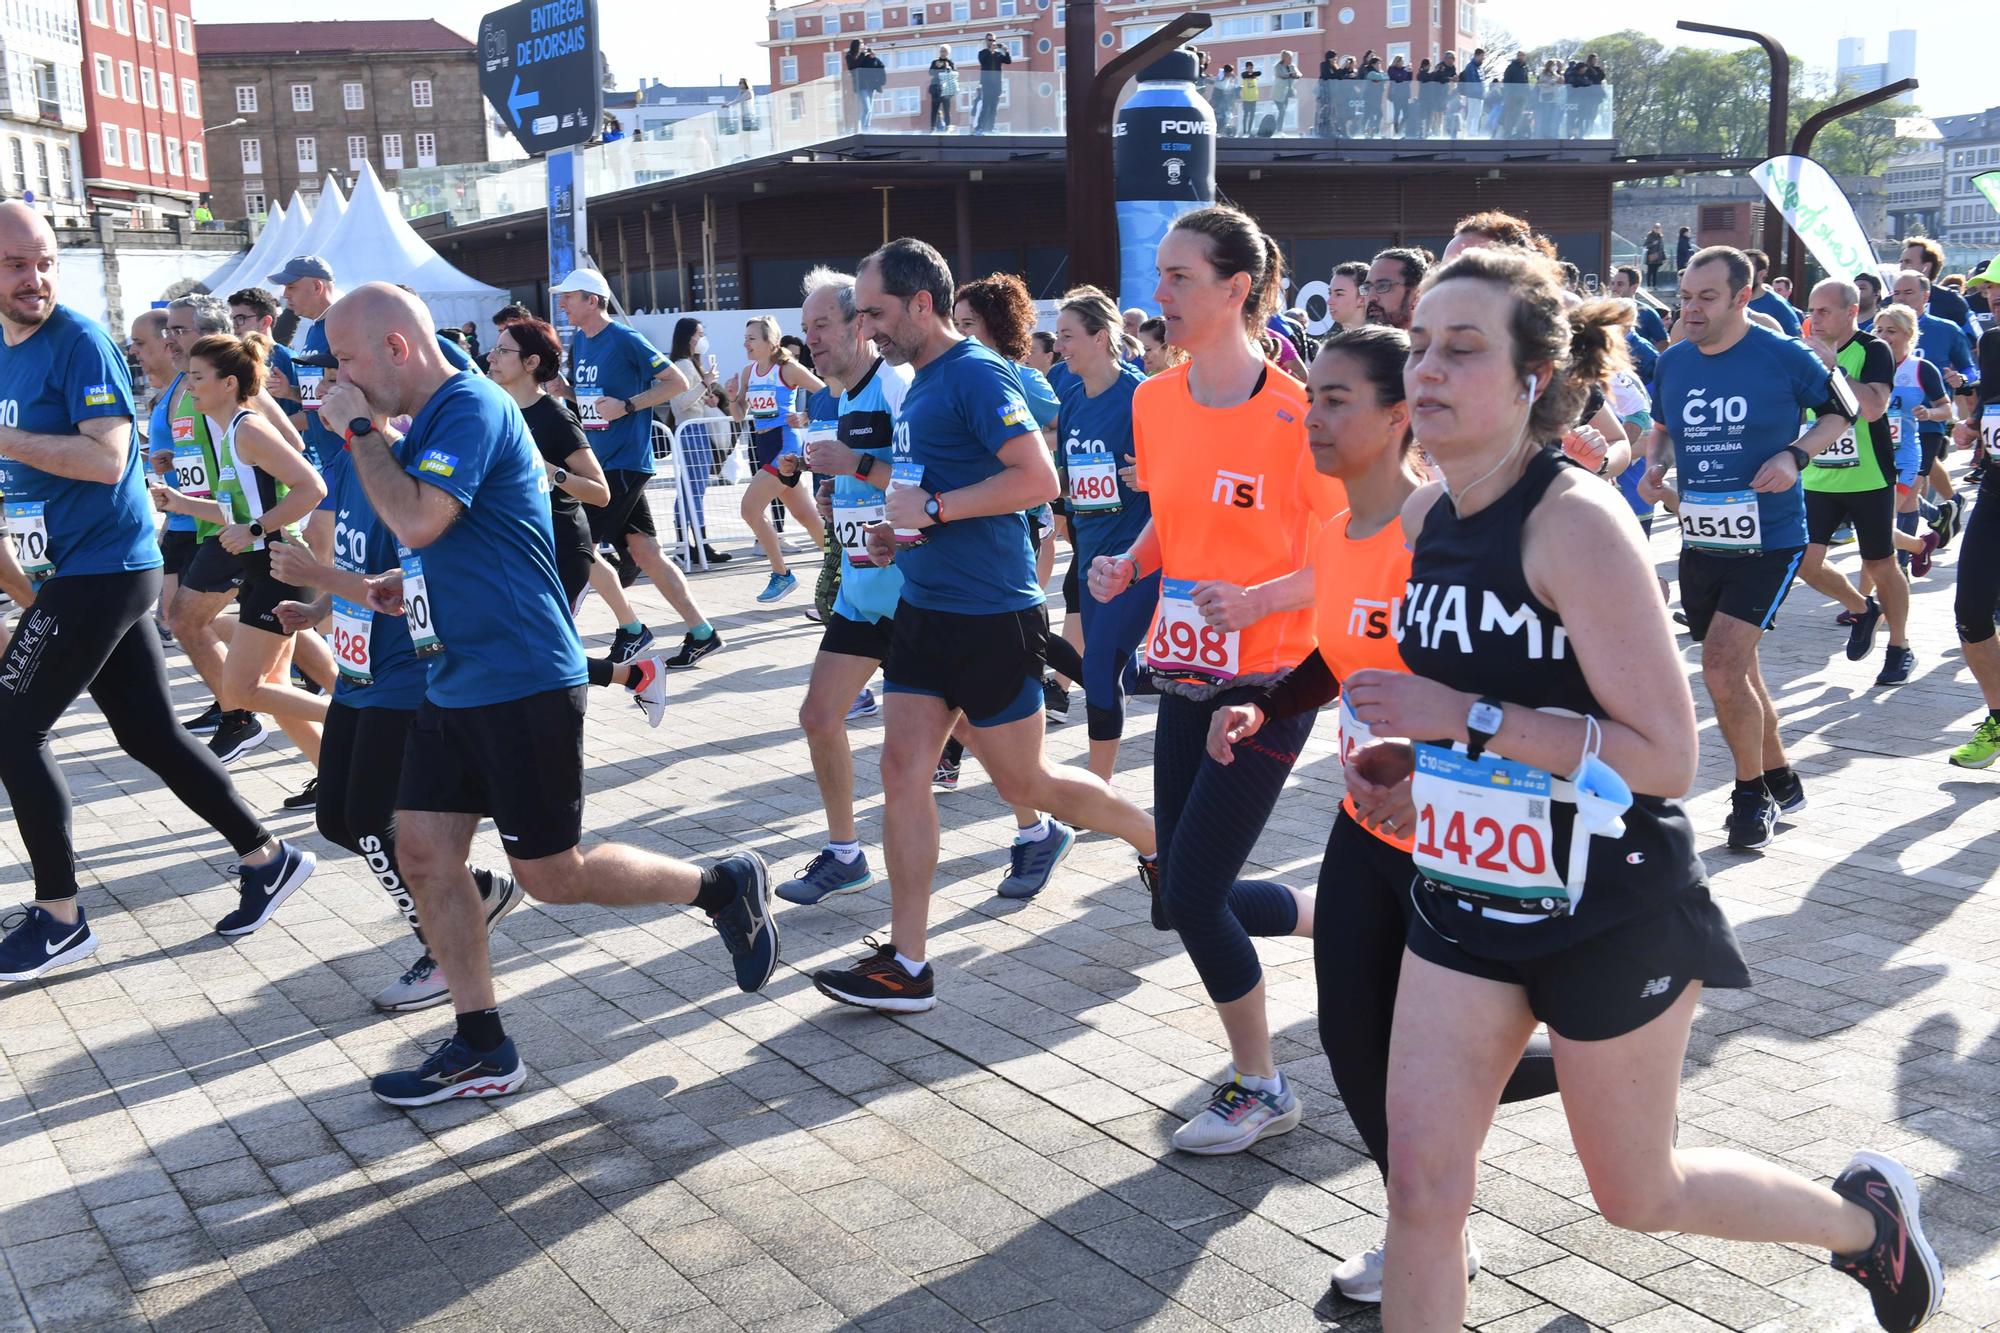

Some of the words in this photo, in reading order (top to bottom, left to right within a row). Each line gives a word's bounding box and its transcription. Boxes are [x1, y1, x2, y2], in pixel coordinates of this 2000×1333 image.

[530, 0, 585, 33] ENTREGA
[516, 40, 532, 67] DE
[534, 25, 585, 63] DORSAIS
[430, 451, 450, 464] PAZ
[1702, 442, 1743, 452] UCRAÍNA
[1070, 475, 1116, 499] 1480
[1211, 469, 1265, 510] nsl
[1683, 515, 1756, 540] 1519
[0, 608, 51, 690] NIKE
[1418, 803, 1546, 875] 1420
